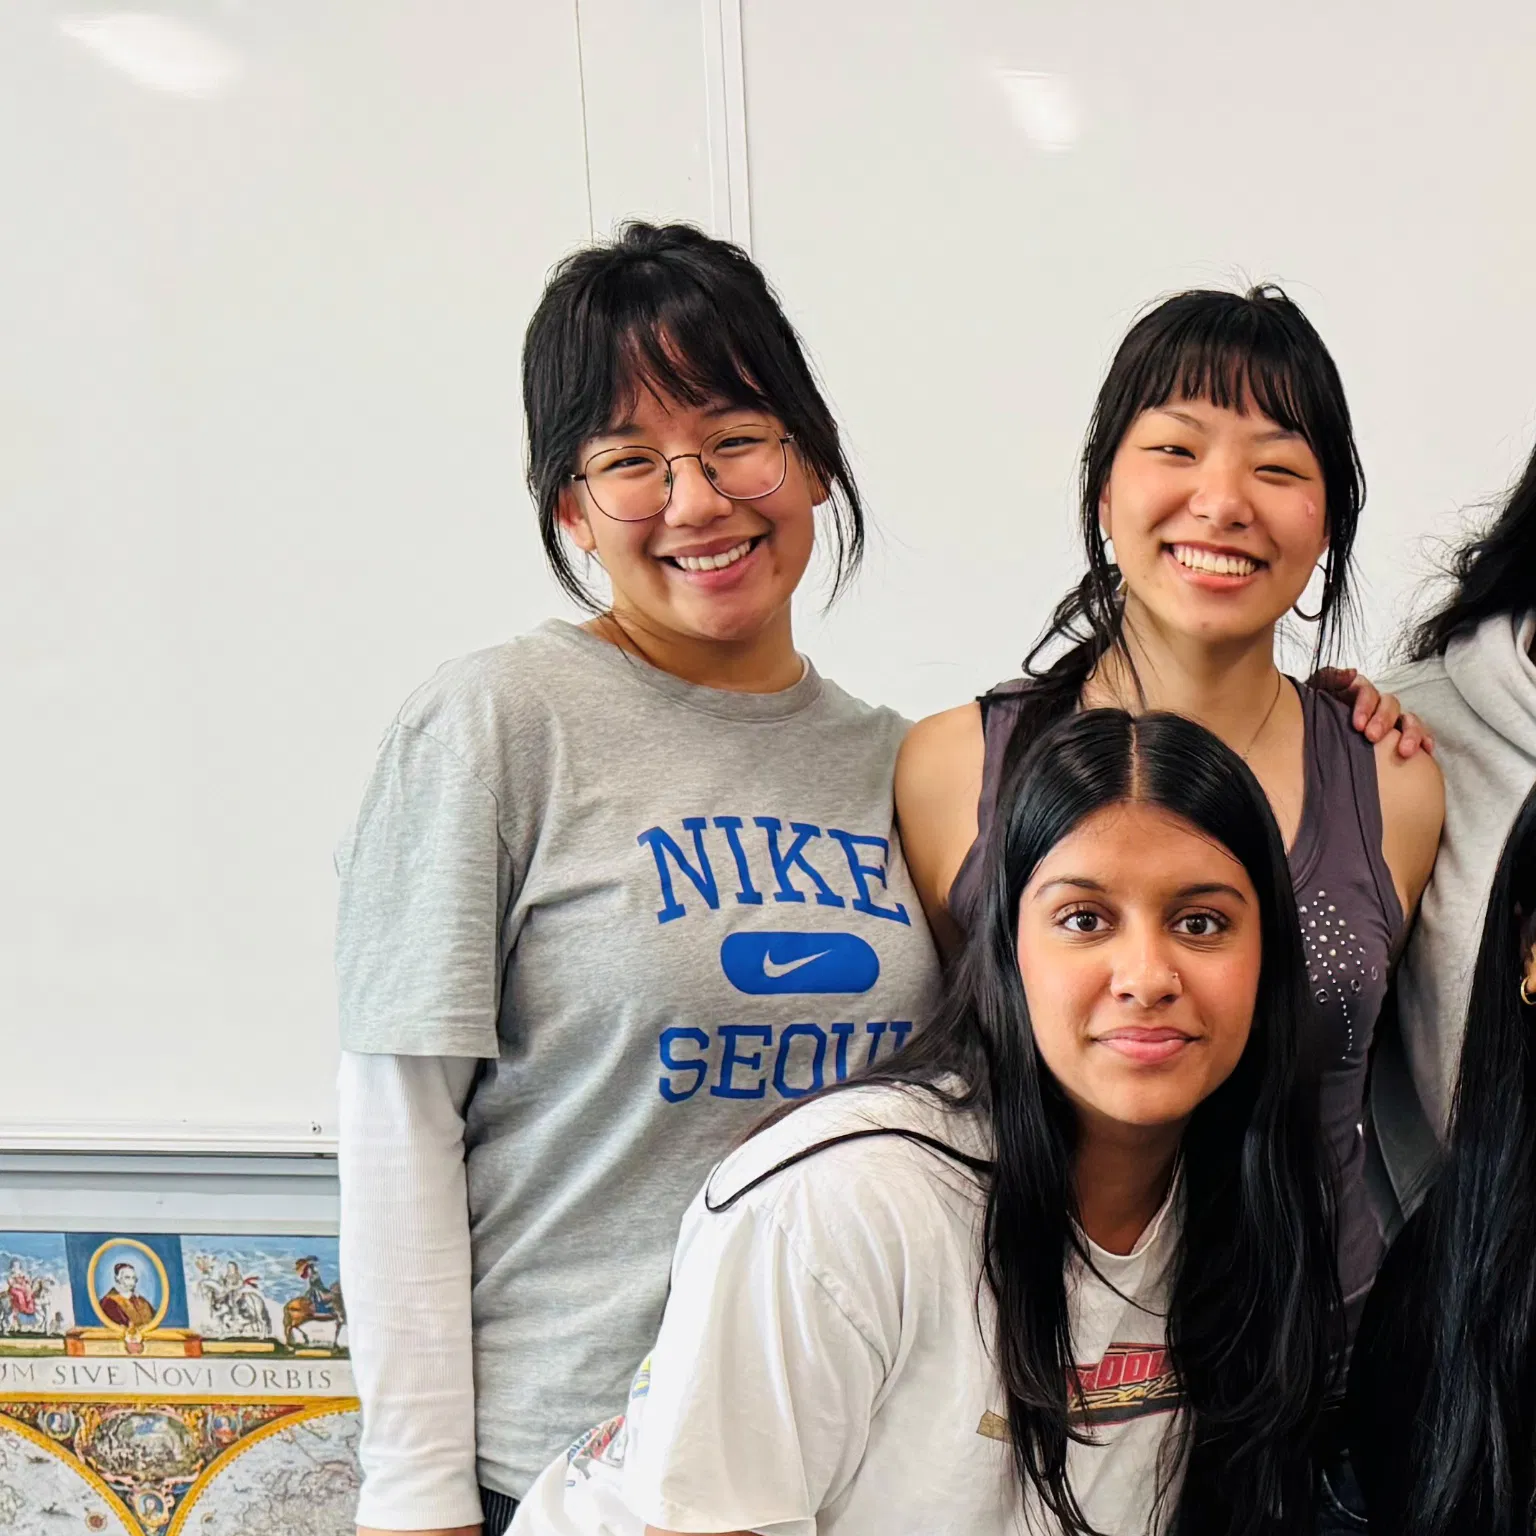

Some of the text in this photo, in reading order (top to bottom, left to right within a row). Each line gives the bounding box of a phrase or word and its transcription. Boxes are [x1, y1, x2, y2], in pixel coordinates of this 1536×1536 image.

[637, 815, 911, 927] NIKE
[659, 1021, 912, 1104] SEOU
[52, 1363, 124, 1386] SIVE
[132, 1361, 213, 1388] NOVI
[230, 1362, 332, 1390] ORBIS
